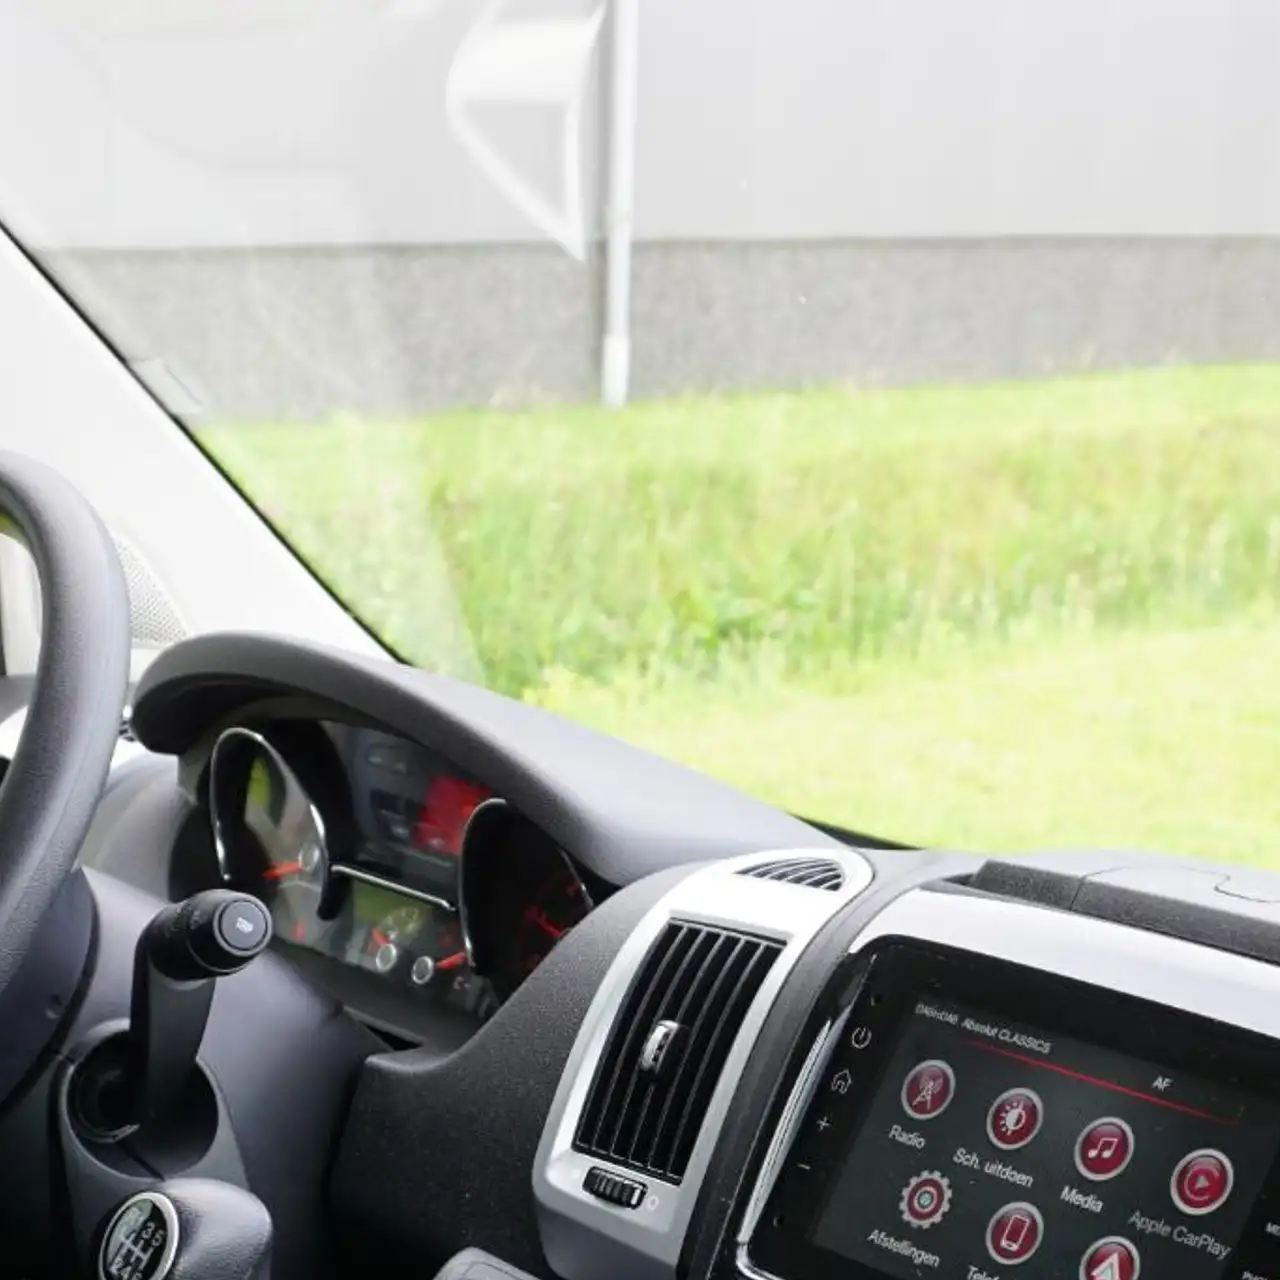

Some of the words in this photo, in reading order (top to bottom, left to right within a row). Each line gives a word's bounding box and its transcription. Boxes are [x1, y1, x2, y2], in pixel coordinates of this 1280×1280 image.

[998, 1028, 1052, 1054] CLASSICS
[1152, 1075, 1173, 1092] AF
[888, 1124, 926, 1149] Radio
[952, 1147, 980, 1169] Sch.
[984, 1160, 1034, 1188] uitdoen
[1060, 1186, 1104, 1214] Media
[867, 1229, 941, 1268] Afstellingen
[1127, 1210, 1172, 1237] Apple
[1172, 1226, 1232, 1261] CarPlay
